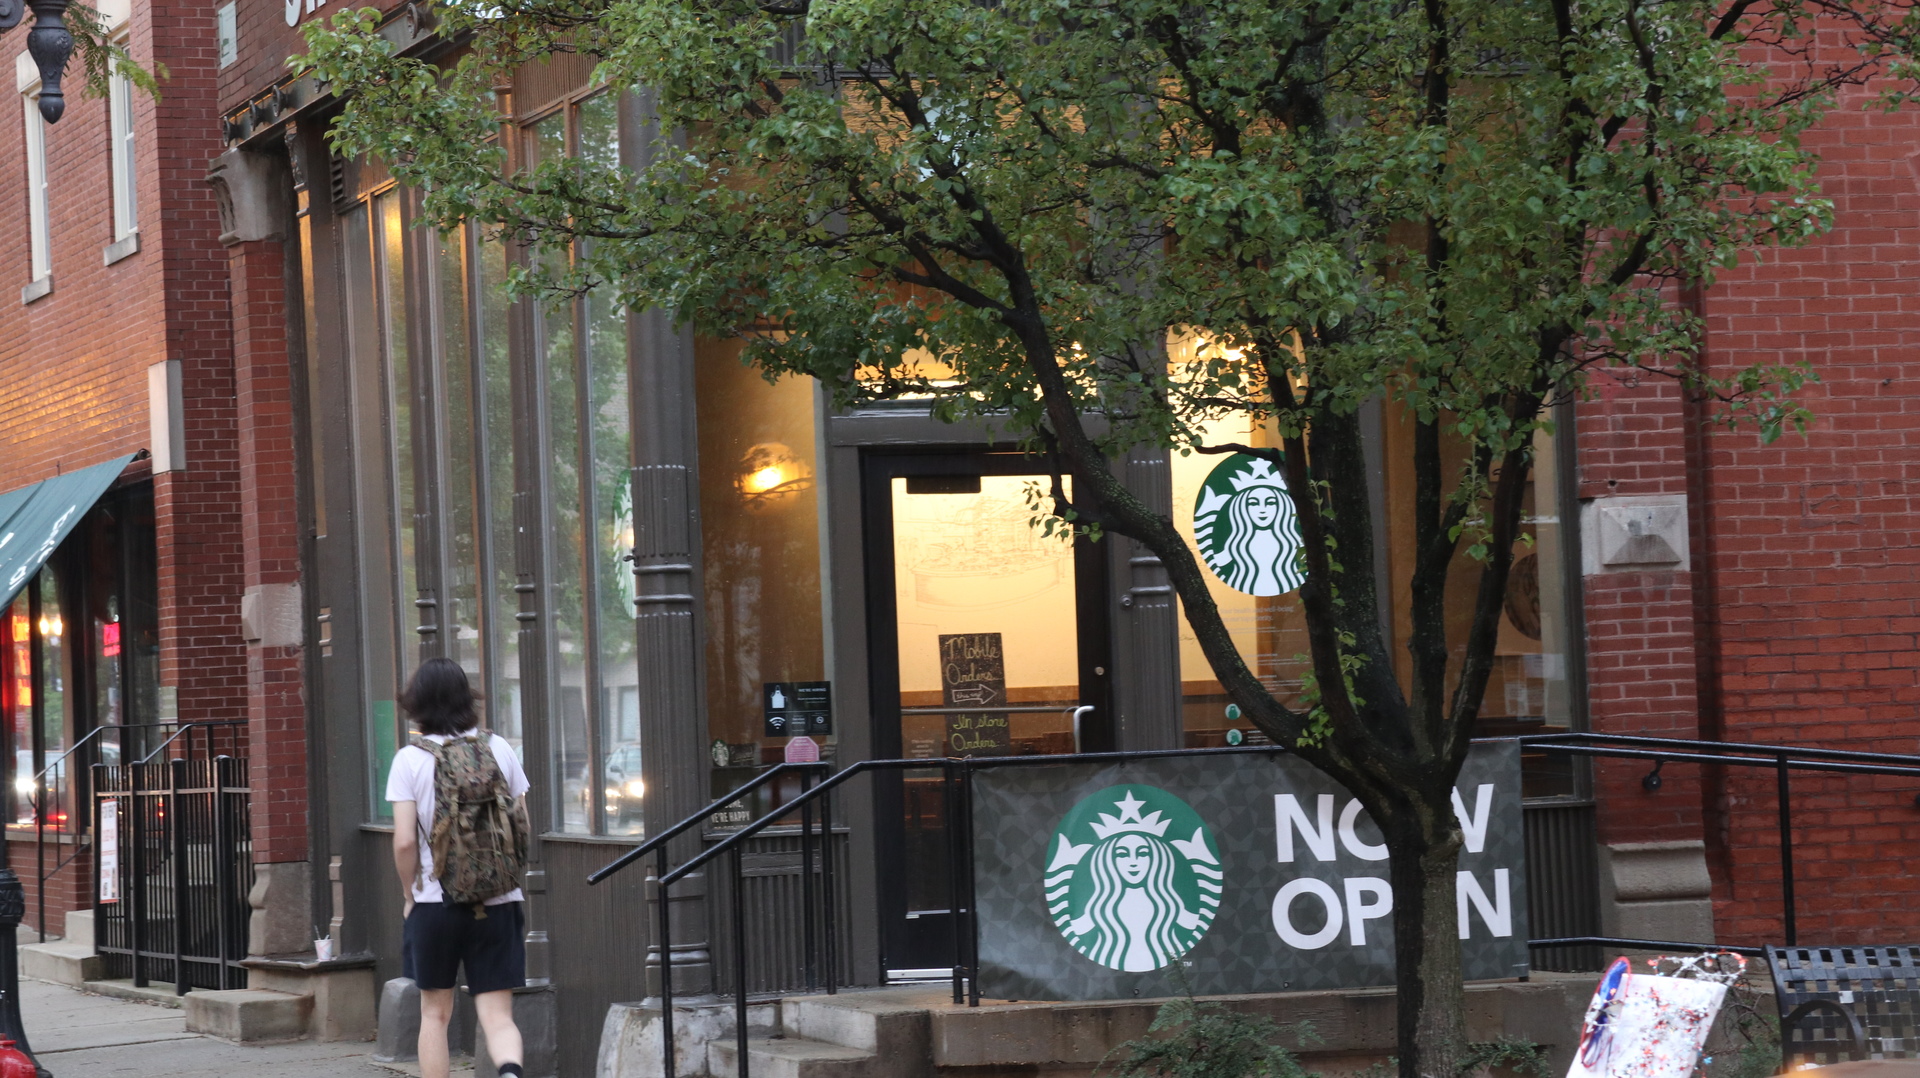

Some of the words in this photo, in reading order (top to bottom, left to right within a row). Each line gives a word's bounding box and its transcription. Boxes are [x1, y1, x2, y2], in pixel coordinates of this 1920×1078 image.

[945, 636, 1000, 659] Mobile
[975, 714, 1008, 729] store
[728, 810, 750, 823] HAPPY
[1272, 868, 1512, 950] OPN
